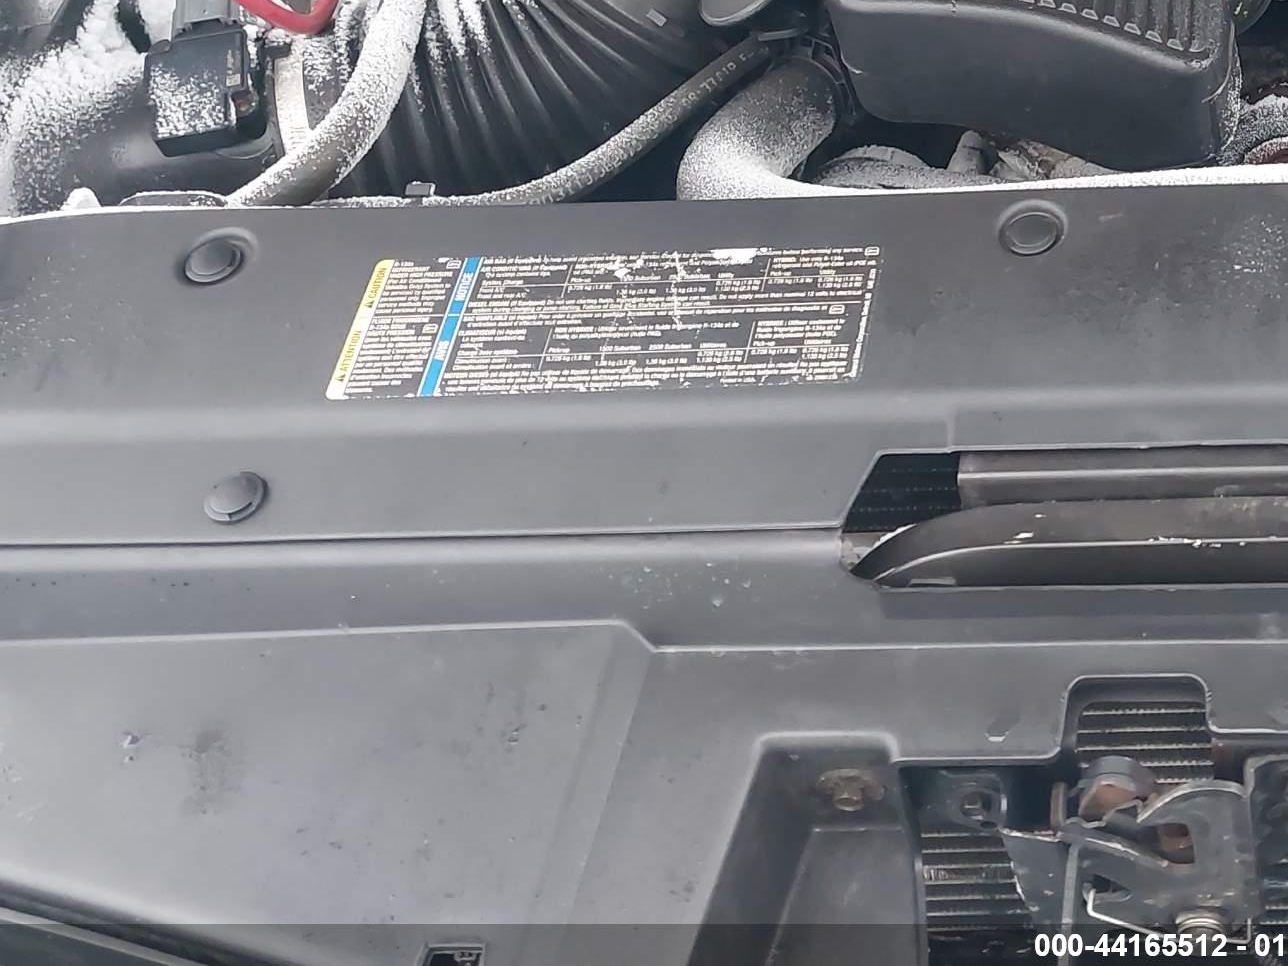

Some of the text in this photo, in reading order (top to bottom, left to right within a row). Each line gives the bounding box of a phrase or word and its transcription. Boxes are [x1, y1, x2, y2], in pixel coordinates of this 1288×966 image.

[369, 268, 387, 299] CAUTION
[455, 272, 474, 301] NOTICE
[340, 330, 361, 372] ATTENTION
